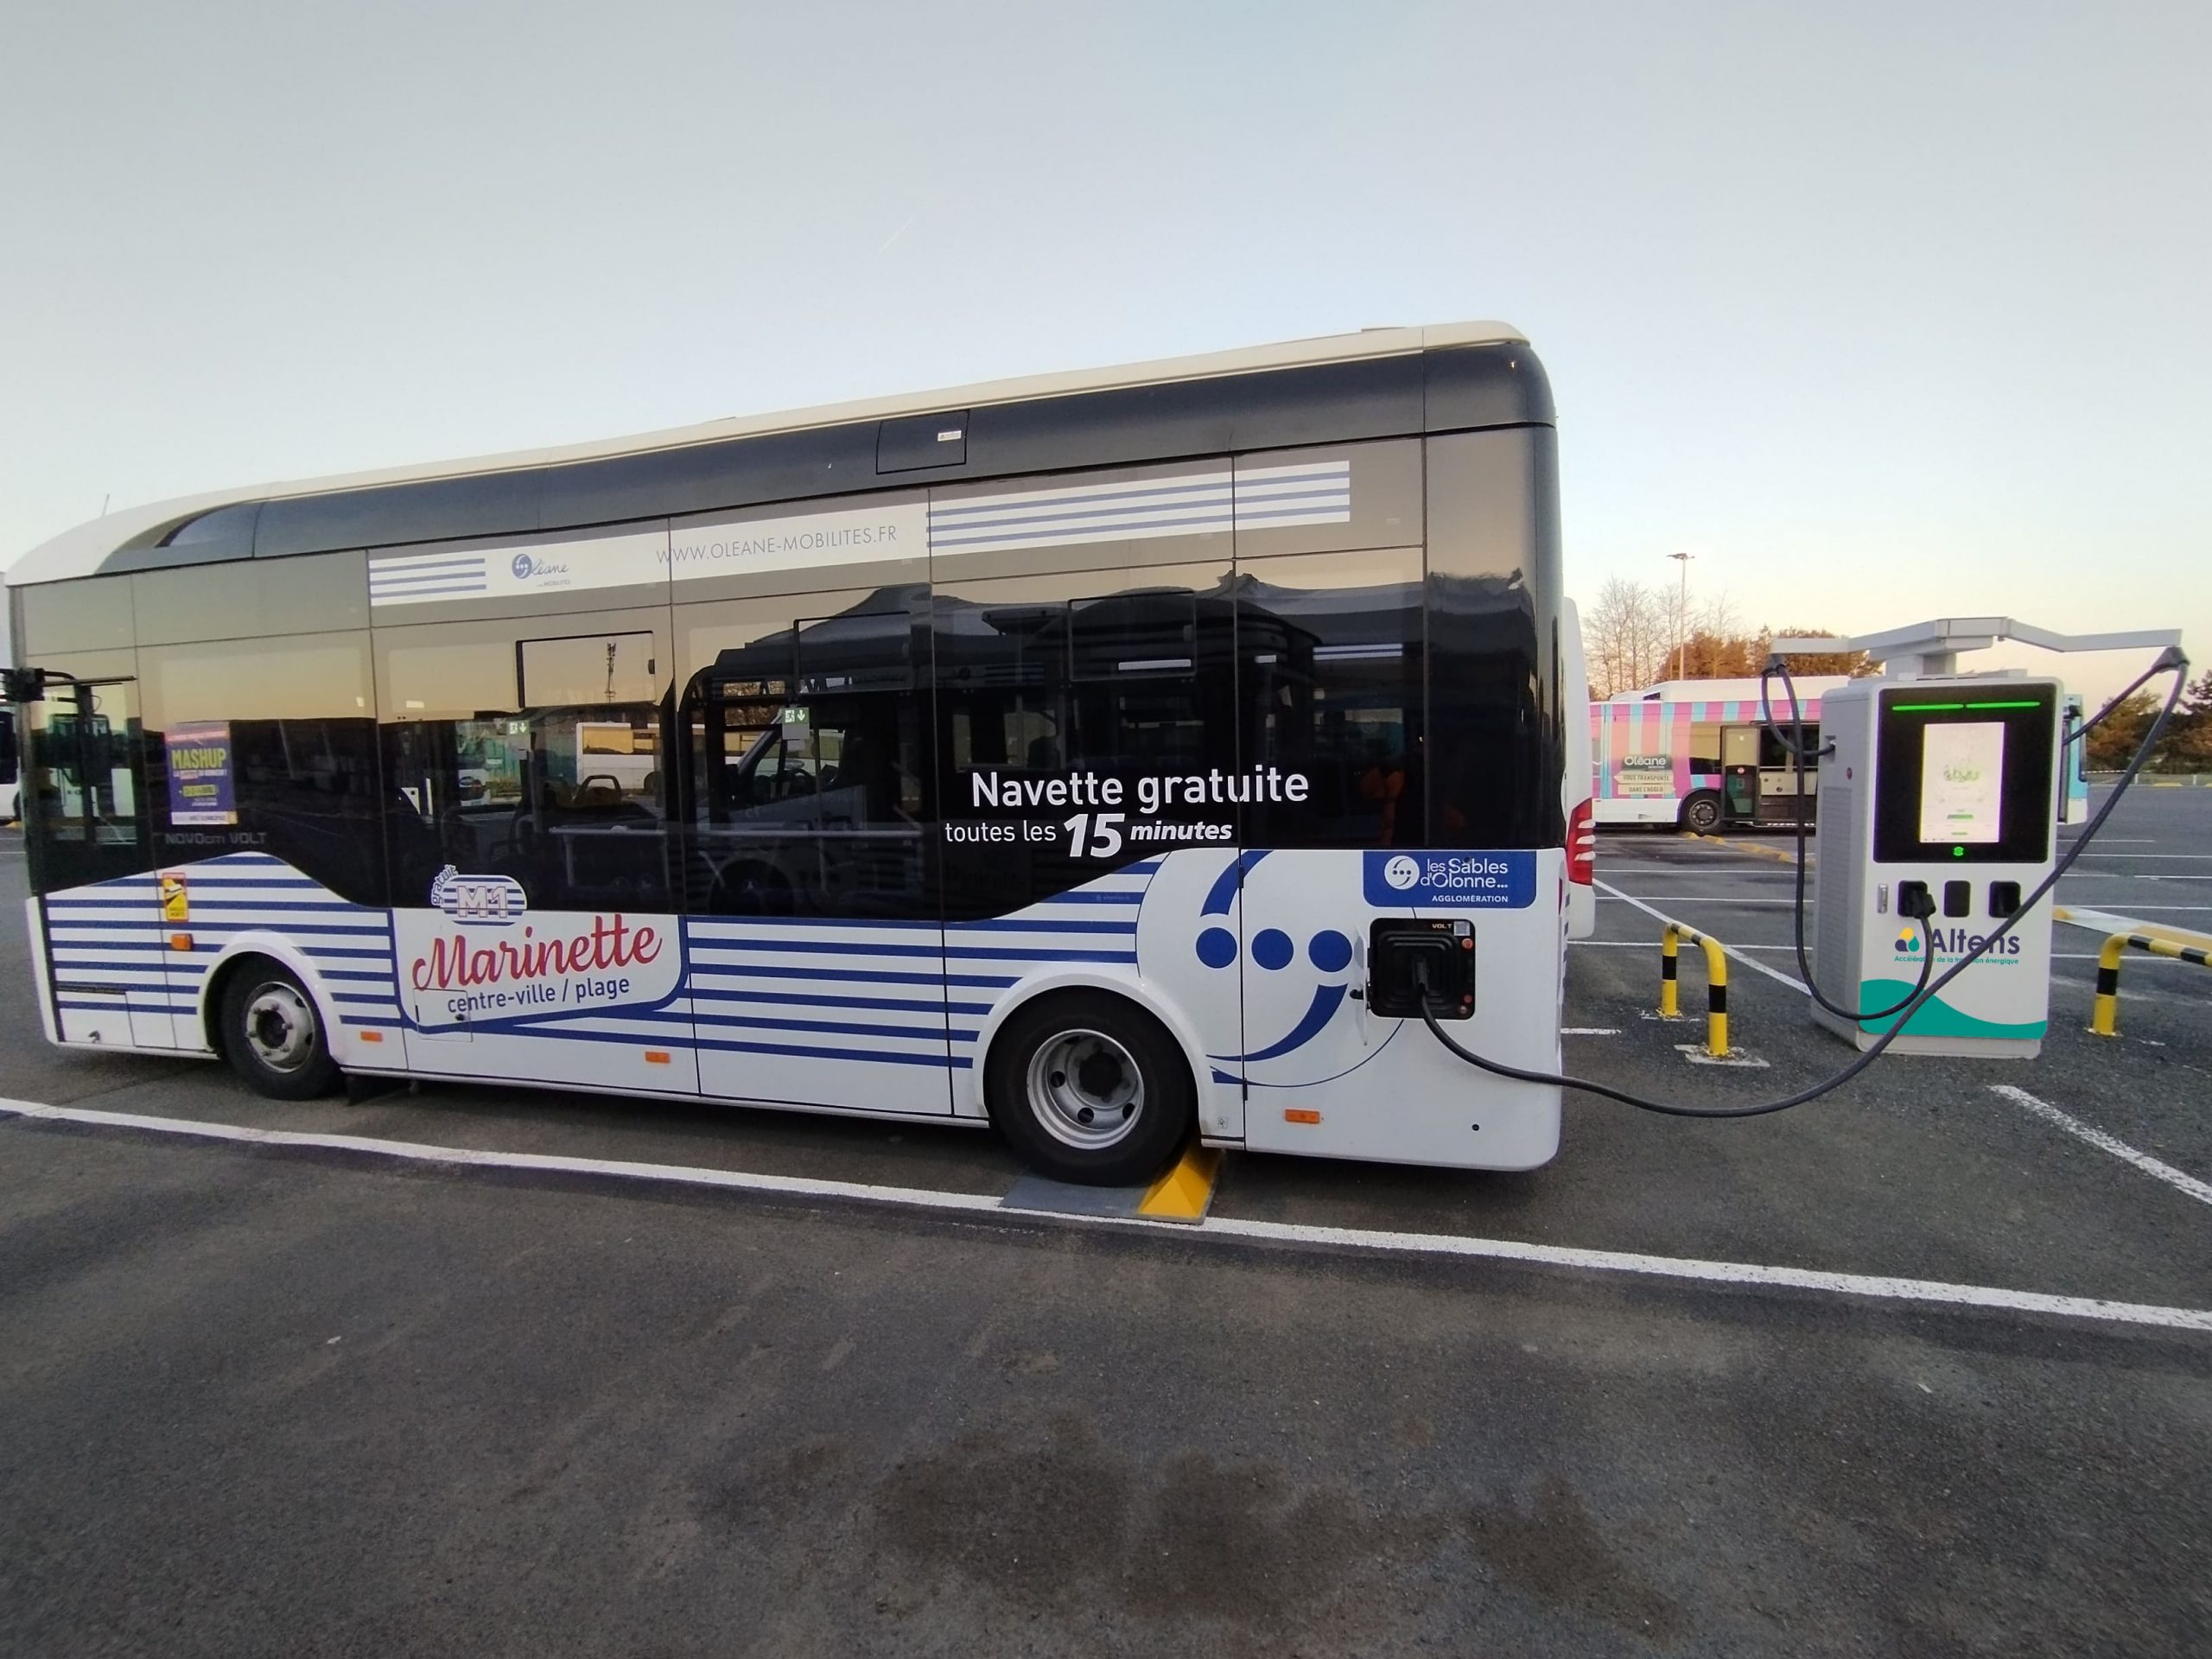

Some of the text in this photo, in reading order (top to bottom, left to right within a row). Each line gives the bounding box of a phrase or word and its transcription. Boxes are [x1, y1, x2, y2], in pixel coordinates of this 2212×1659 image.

[657, 525, 897, 563] WWW.OLEANE-MOBILITES.FR
[172, 747, 226, 769] MASHUP
[972, 765, 1309, 814] Navette gratuite
[945, 813, 1232, 858] toutes les 15 minutes
[1427, 857, 1509, 874] les Sables
[432, 865, 458, 905] gratuit
[457, 886, 507, 918] M1
[412, 912, 663, 991] Marinette
[1932, 928, 2020, 955] Altens
[448, 983, 556, 1013] centre-ville
[575, 978, 630, 1003] plage
